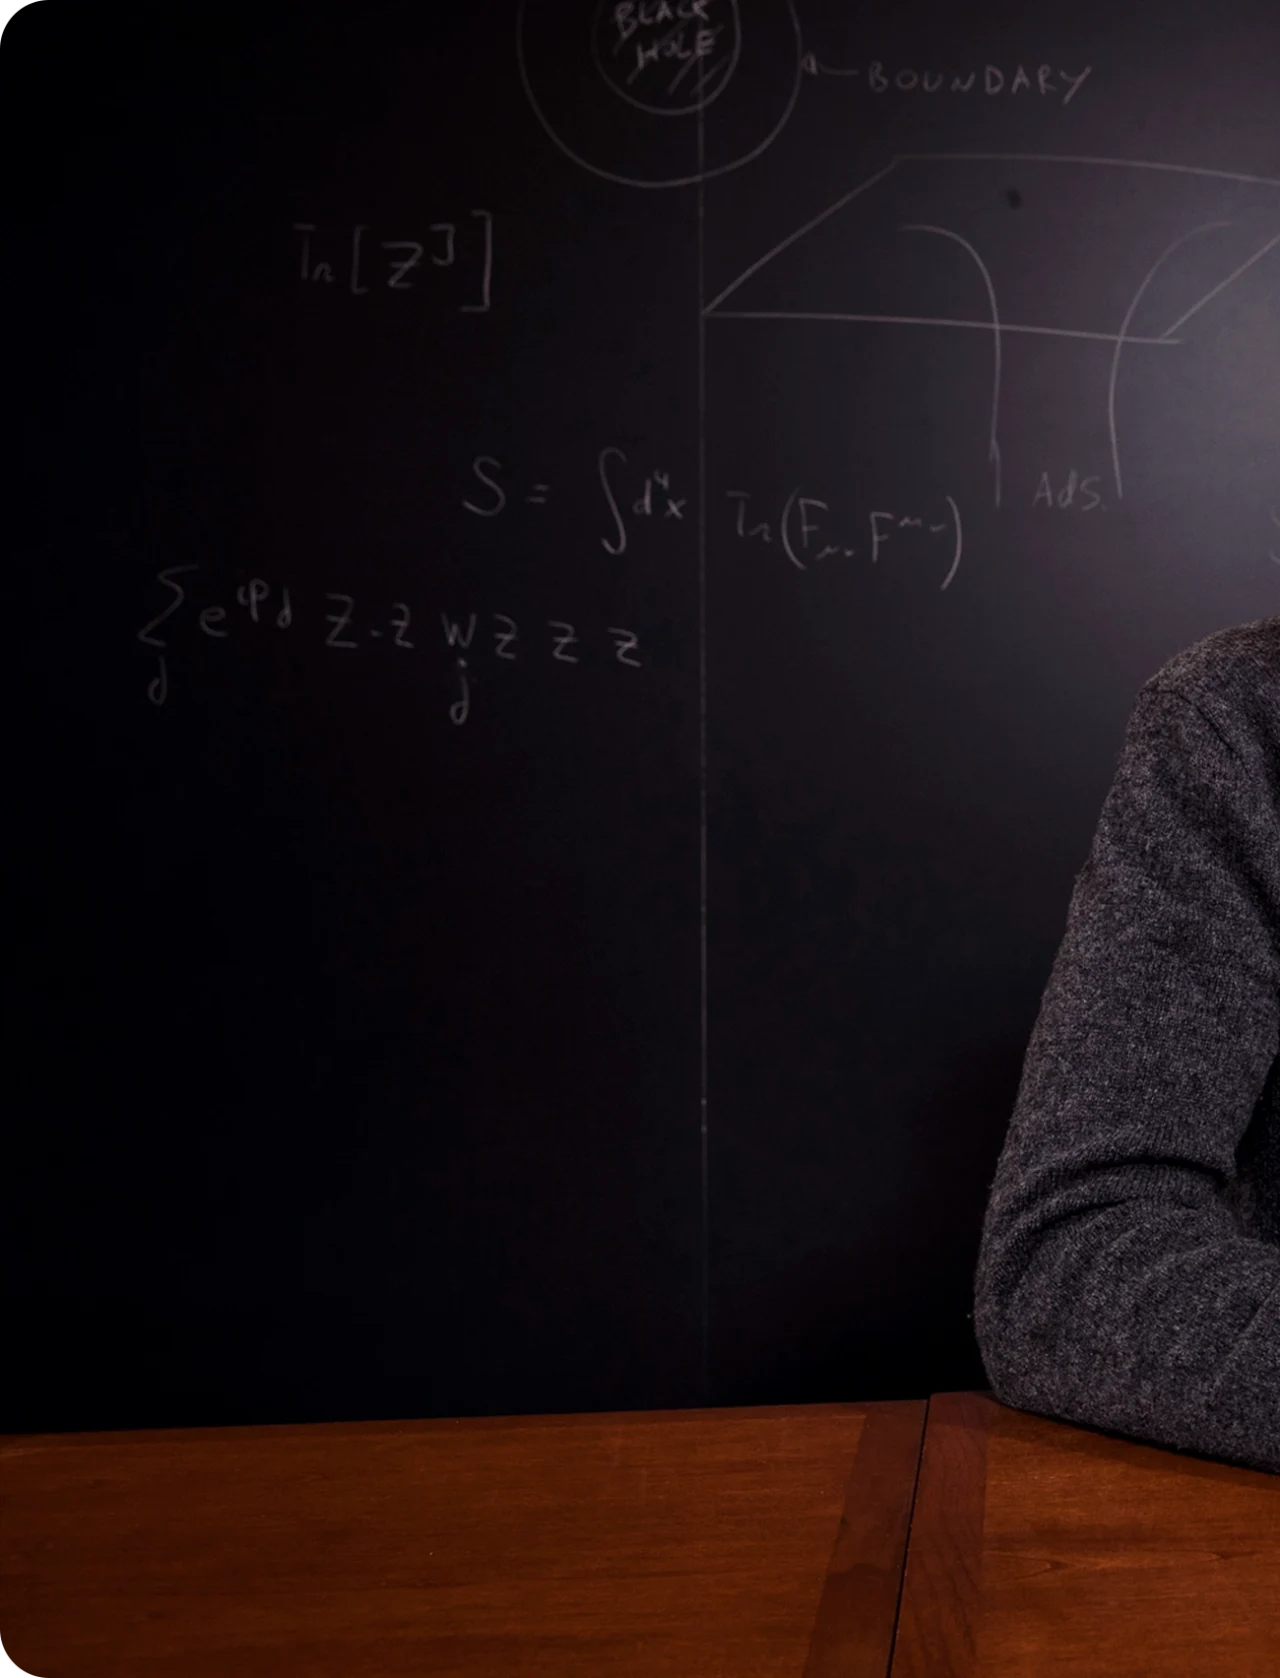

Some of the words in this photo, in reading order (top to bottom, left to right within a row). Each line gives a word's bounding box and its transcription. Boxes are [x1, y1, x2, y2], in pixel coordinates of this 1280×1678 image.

[612, 0, 710, 40] BLACK
[635, 28, 716, 70] HOLE
[867, 64, 1093, 104] BOUNDARY
